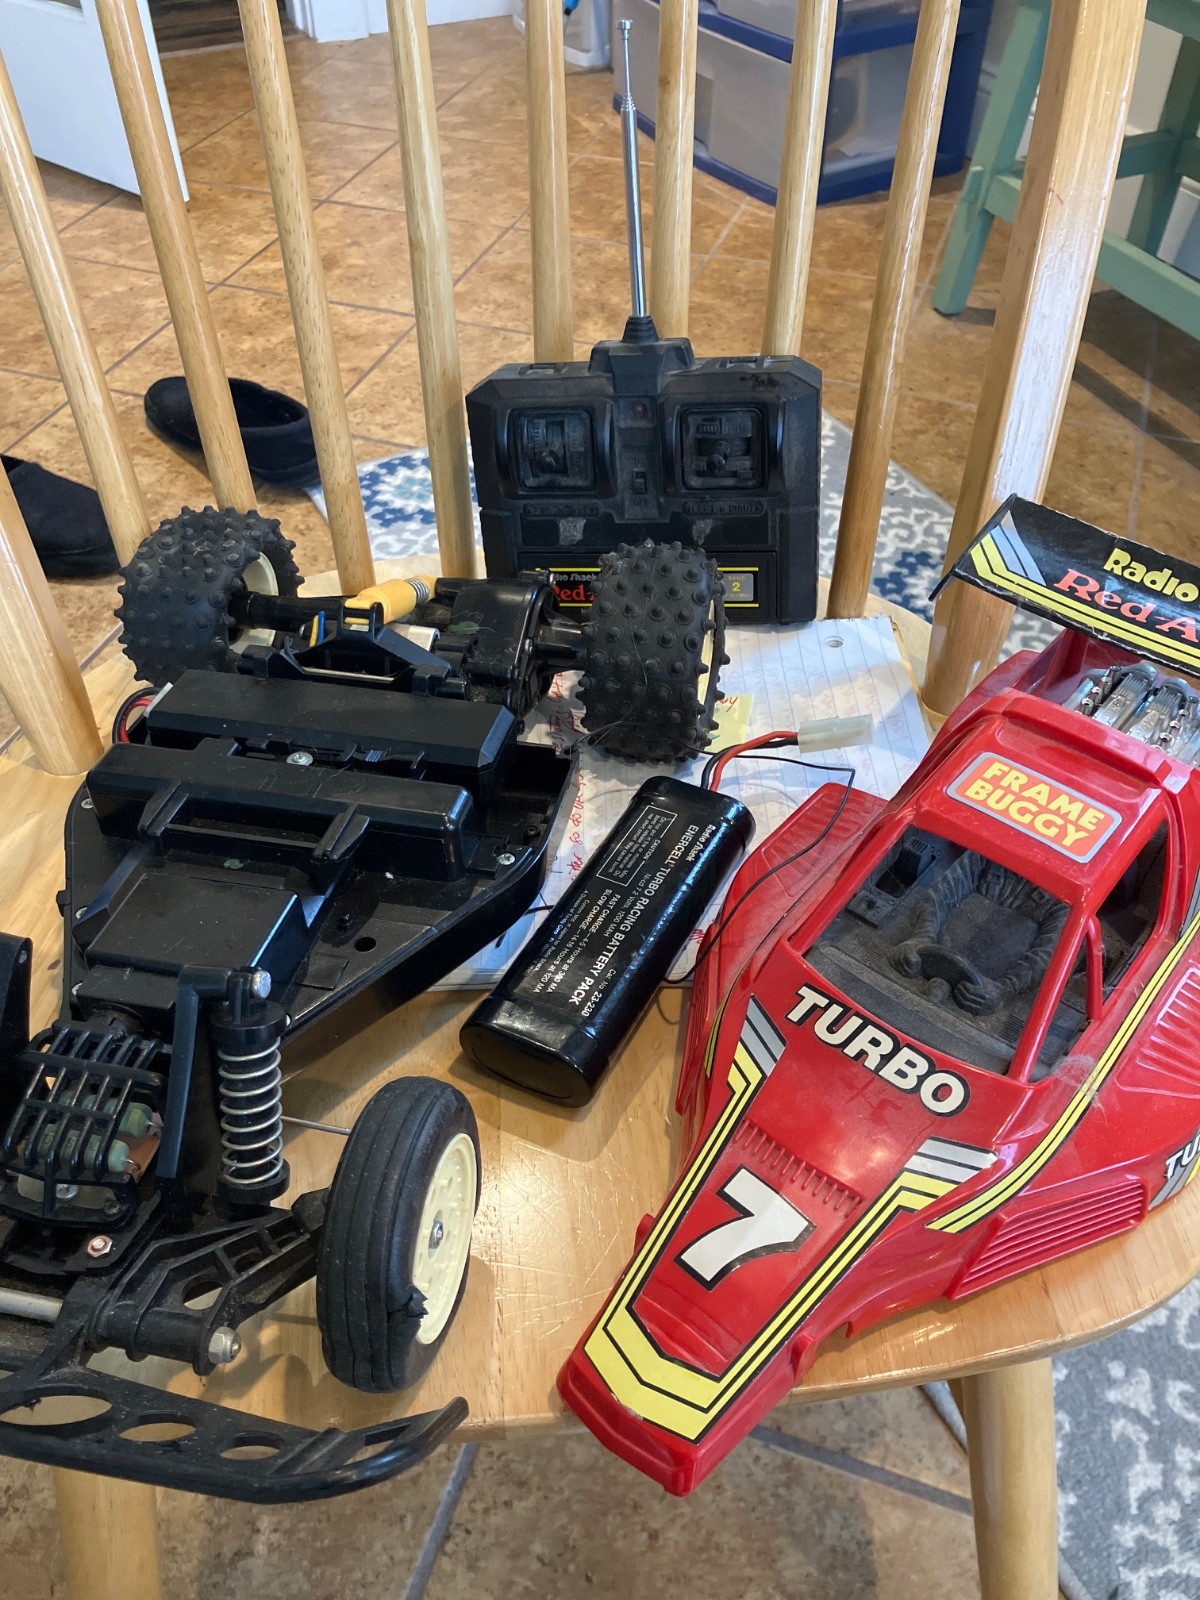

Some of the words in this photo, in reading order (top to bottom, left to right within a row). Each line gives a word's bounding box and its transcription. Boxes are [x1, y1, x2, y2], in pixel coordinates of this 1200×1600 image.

[1103, 547, 1199, 602] Radio
[731, 581, 741, 592] 2
[982, 762, 1105, 830] FRAME
[964, 779, 1089, 847] BUGGY
[698, 824, 716, 843] Radio
[642, 839, 660, 860] CAUTION
[684, 842, 703, 862] Shack
[643, 865, 670, 896] TURBO
[596, 888, 612, 905] SLOW
[606, 893, 620, 908] FAST
[578, 905, 600, 930] CHARGE
[588, 908, 610, 933] CHARGE
[618, 896, 649, 932] RACING
[603, 922, 616, 937] MAH
[552, 947, 569, 965] Hours
[566, 946, 582, 964] Hours
[589, 931, 625, 975] BATTERY
[532, 982, 544, 994] MA
[540, 971, 551, 982] 120
[545, 982, 557, 993] MA
[568, 976, 594, 1005] PACK
[580, 991, 602, 1016] 23-230
[786, 984, 968, 1115] TURBO
[676, 1165, 813, 1287] 7
